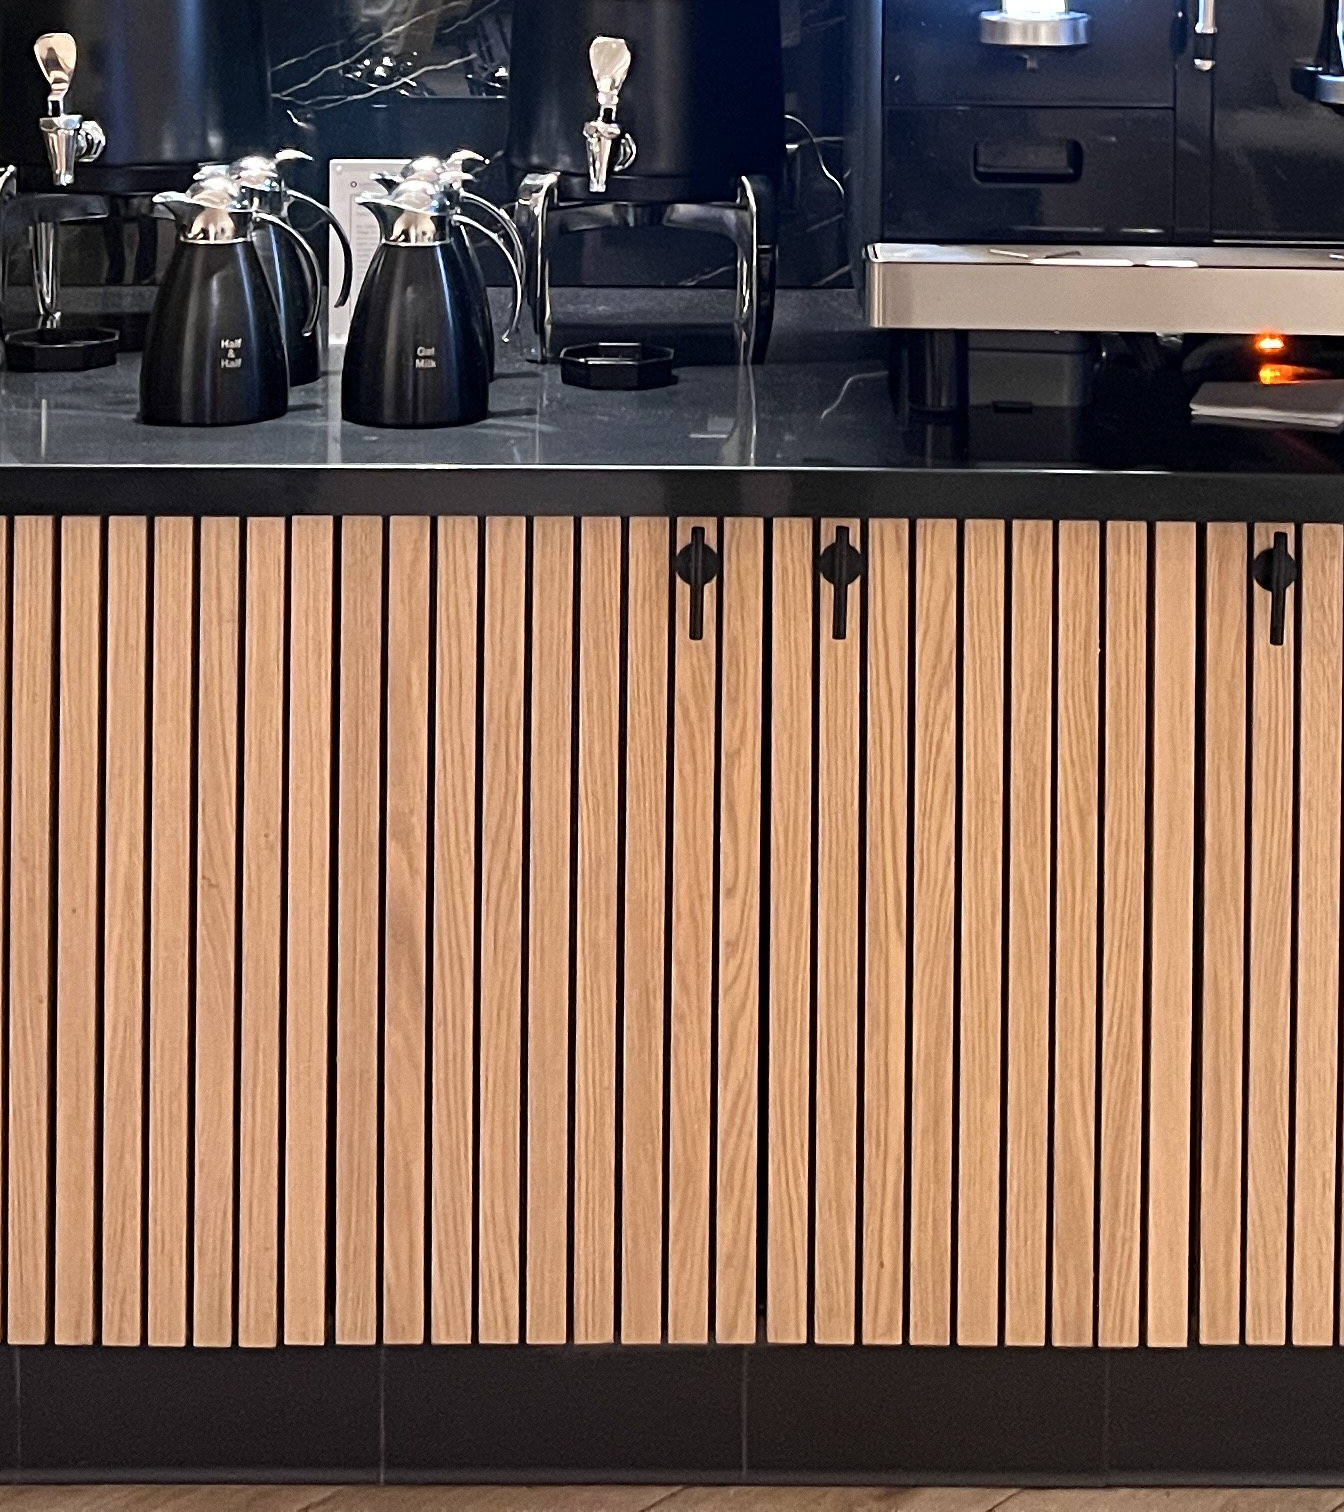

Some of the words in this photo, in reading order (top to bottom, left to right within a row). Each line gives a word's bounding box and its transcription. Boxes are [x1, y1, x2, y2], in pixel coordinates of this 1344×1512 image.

[220, 338, 242, 349] Half
[220, 358, 242, 368] Half
[415, 358, 437, 368] Milk
